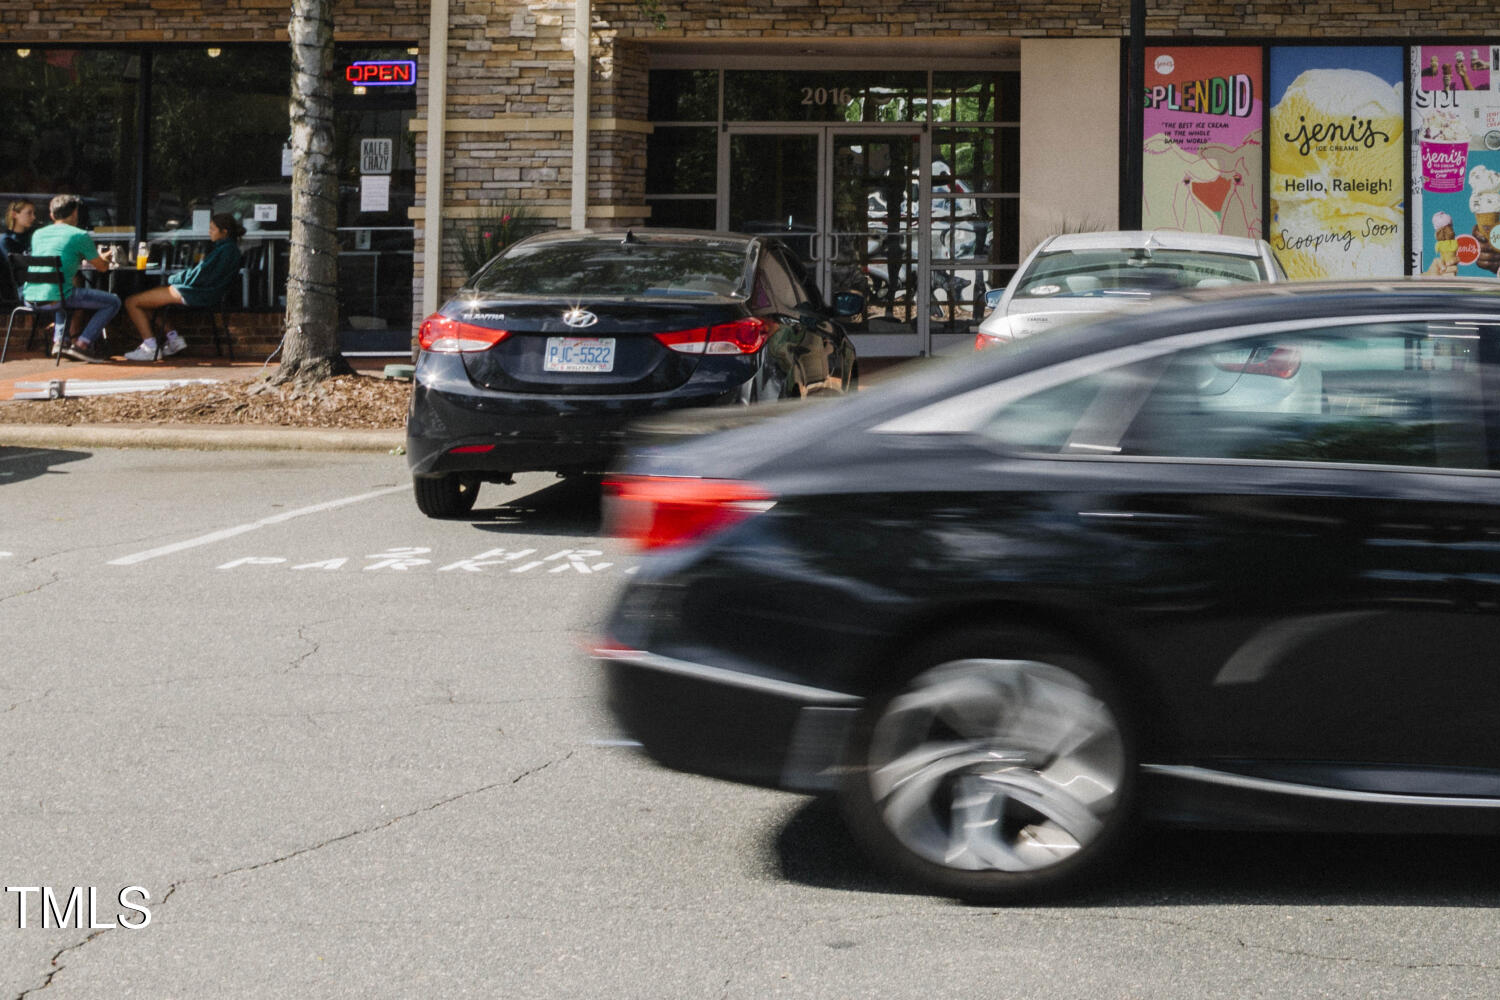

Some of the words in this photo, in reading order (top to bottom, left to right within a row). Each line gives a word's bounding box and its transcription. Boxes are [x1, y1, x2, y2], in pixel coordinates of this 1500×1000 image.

[346, 65, 410, 81] OPEN
[801, 87, 852, 105] 2016
[1143, 74, 1254, 118] SPLENDID
[1284, 116, 1389, 156] jeni's
[1423, 148, 1466, 168] jeni's
[1285, 179, 1328, 194] Hello,
[1333, 179, 1392, 194] Raleigh!
[1276, 229, 1355, 252] Scooping
[1361, 218, 1398, 238] Soon
[550, 346, 610, 364] PJC-5522
[366, 546, 432, 559] 2
[473, 548, 604, 561] HR
